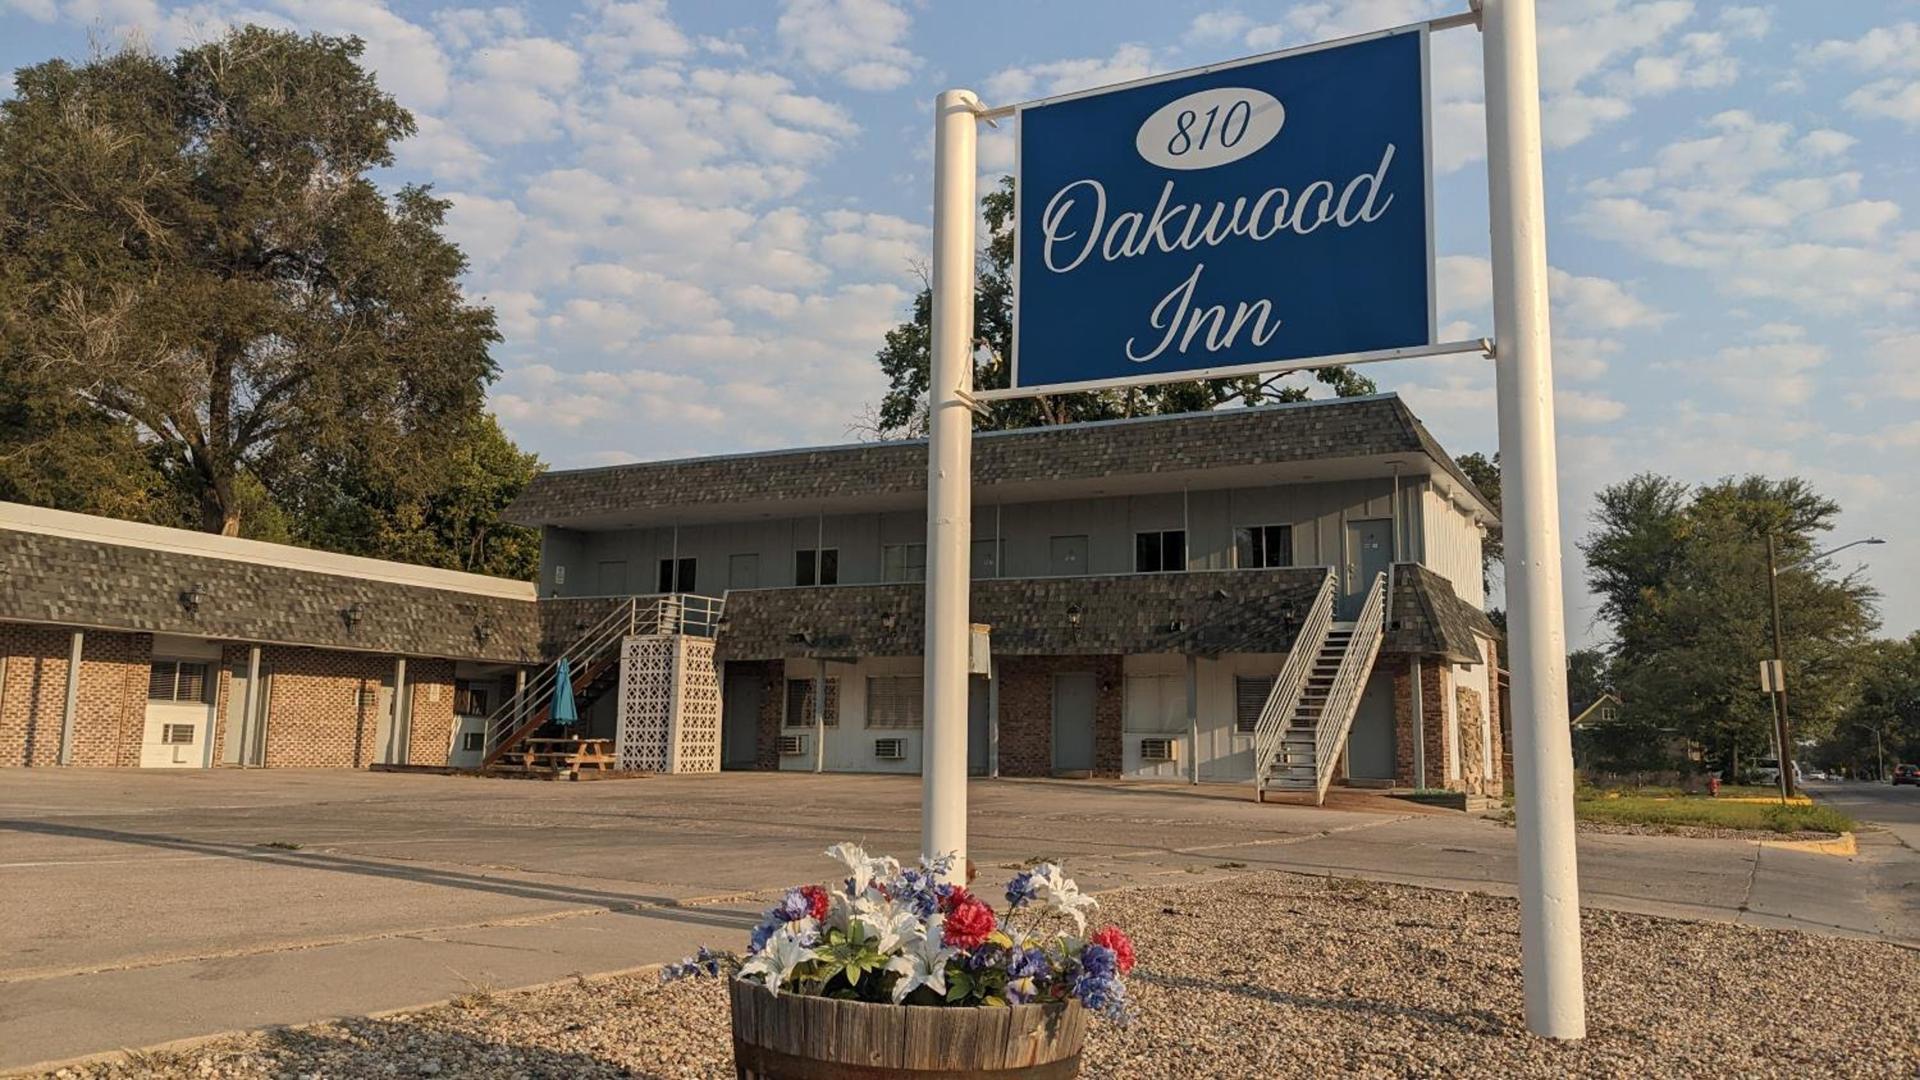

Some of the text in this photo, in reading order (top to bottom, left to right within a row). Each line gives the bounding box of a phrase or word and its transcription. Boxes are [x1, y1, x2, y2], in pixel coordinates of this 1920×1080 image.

[1167, 101, 1251, 156] 810
[1042, 143, 1396, 273] Oakwood
[1125, 263, 1281, 362] Inn
